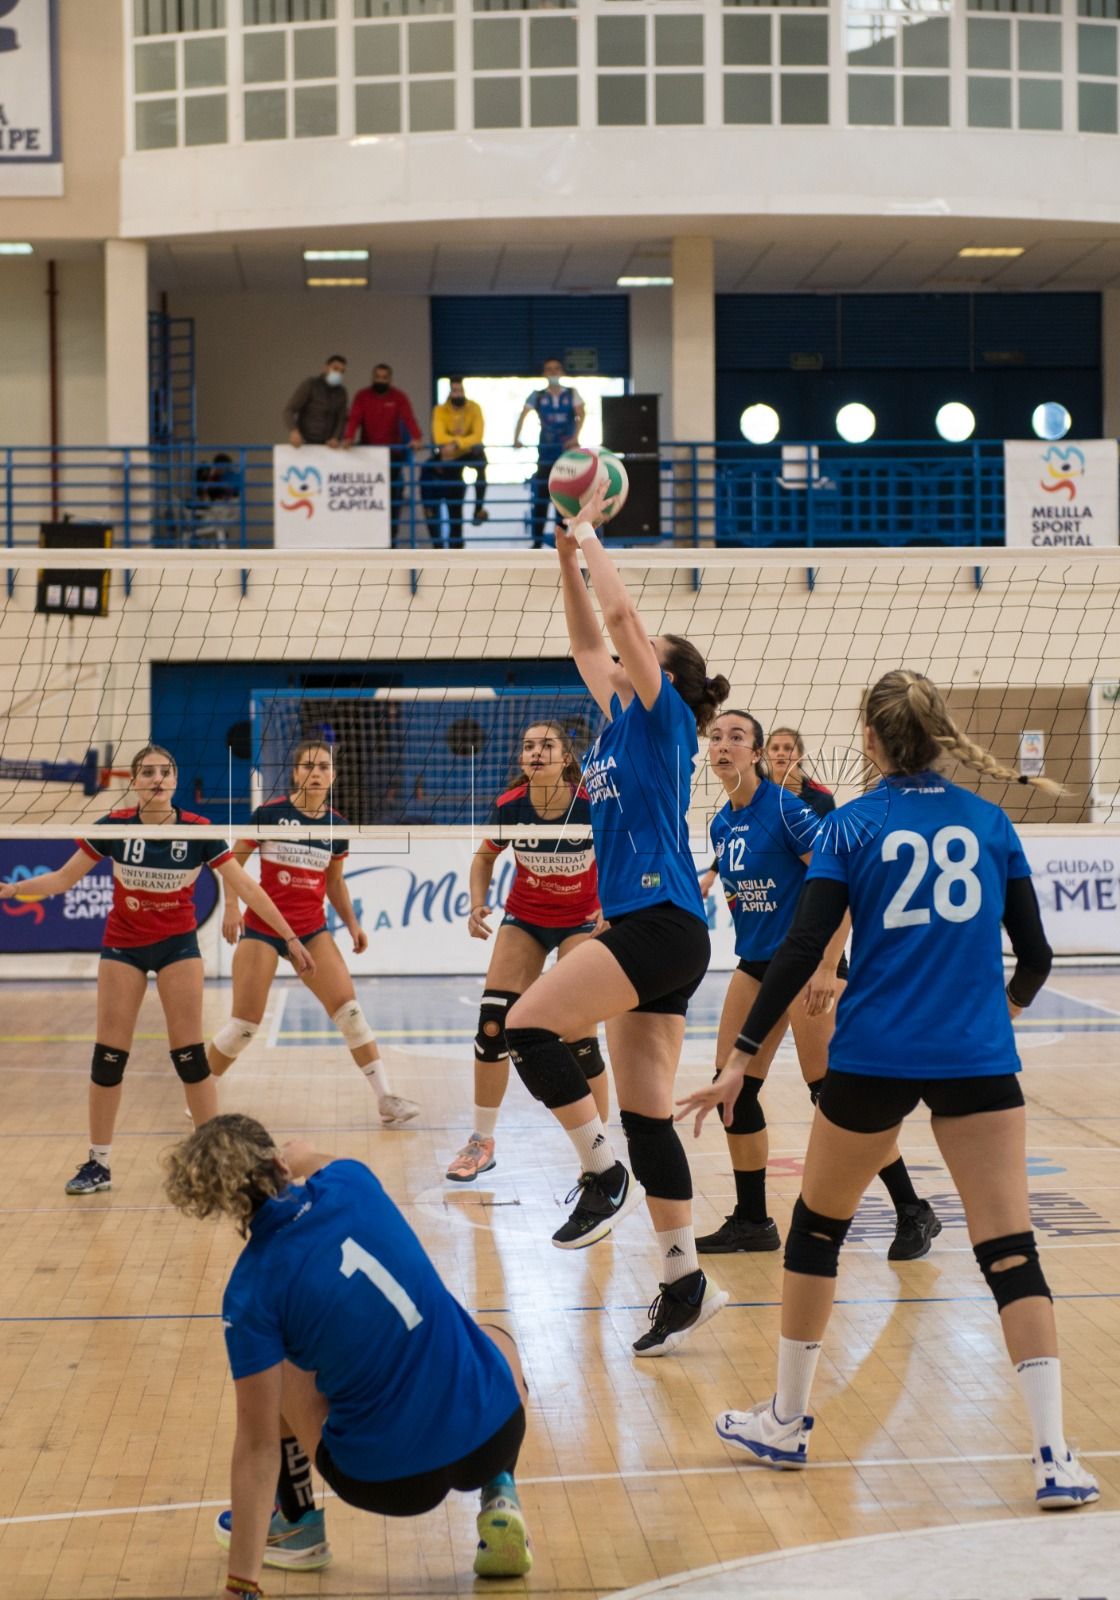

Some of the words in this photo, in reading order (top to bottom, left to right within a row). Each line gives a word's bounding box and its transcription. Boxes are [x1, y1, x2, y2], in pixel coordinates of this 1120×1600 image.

[328, 472, 385, 483] MELILLA
[328, 486, 374, 497] SPORT
[328, 499, 385, 511] CAPITAL
[1032, 506, 1093, 518] MELILLA
[1032, 521, 1081, 533] SPORT
[1032, 535, 1092, 546] CAPITAL
[123, 838, 146, 864] 19
[728, 838, 745, 872] 12
[531, 863, 587, 874] GRANADA
[1046, 859, 1115, 874] CIUDAD
[881, 825, 982, 929] 28
[65, 890, 114, 904] SPOR
[1052, 878, 1120, 912] ME
[339, 1236, 424, 1332] 1
